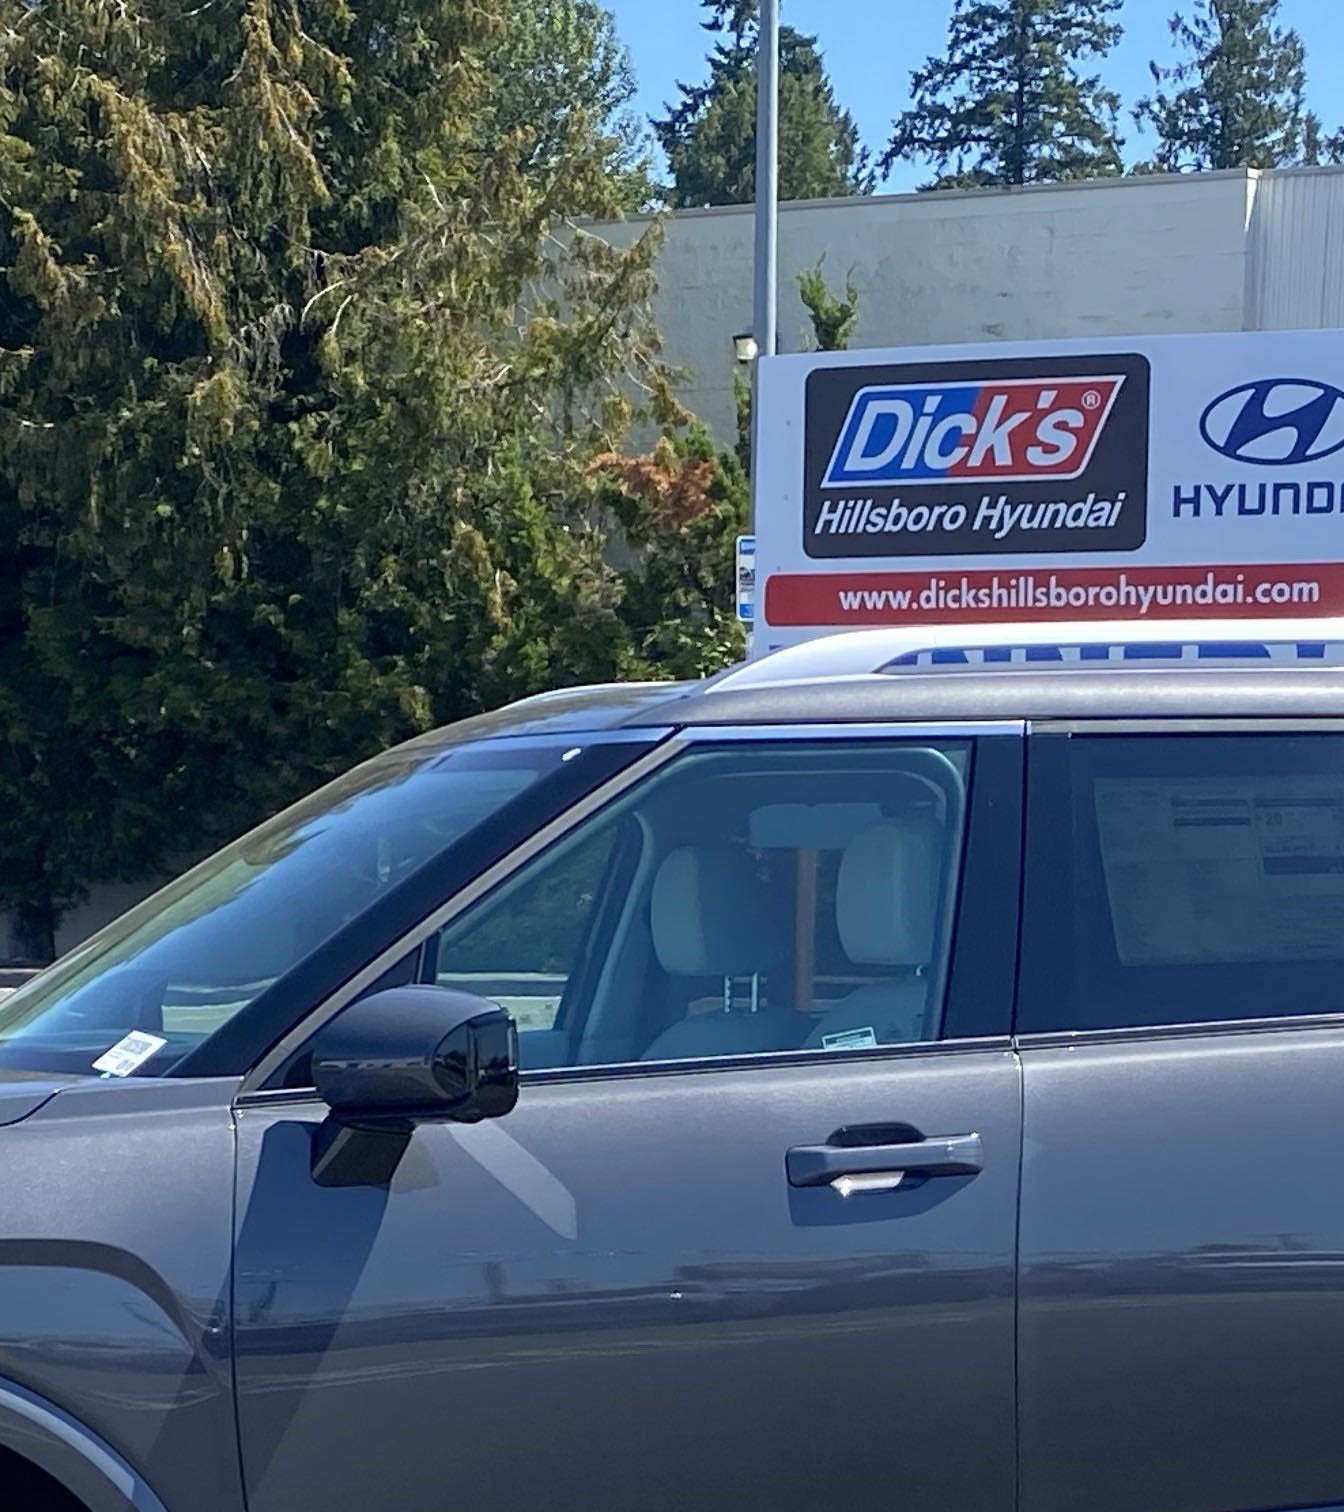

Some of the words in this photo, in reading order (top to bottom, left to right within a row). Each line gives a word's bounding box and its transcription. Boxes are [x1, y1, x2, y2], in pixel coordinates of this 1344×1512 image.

[844, 391, 1085, 473] Dick's
[814, 499, 967, 535] Hillsboro
[972, 493, 1126, 538] Hyundai
[838, 573, 1320, 612] www.dickshillsborohyundai.com
